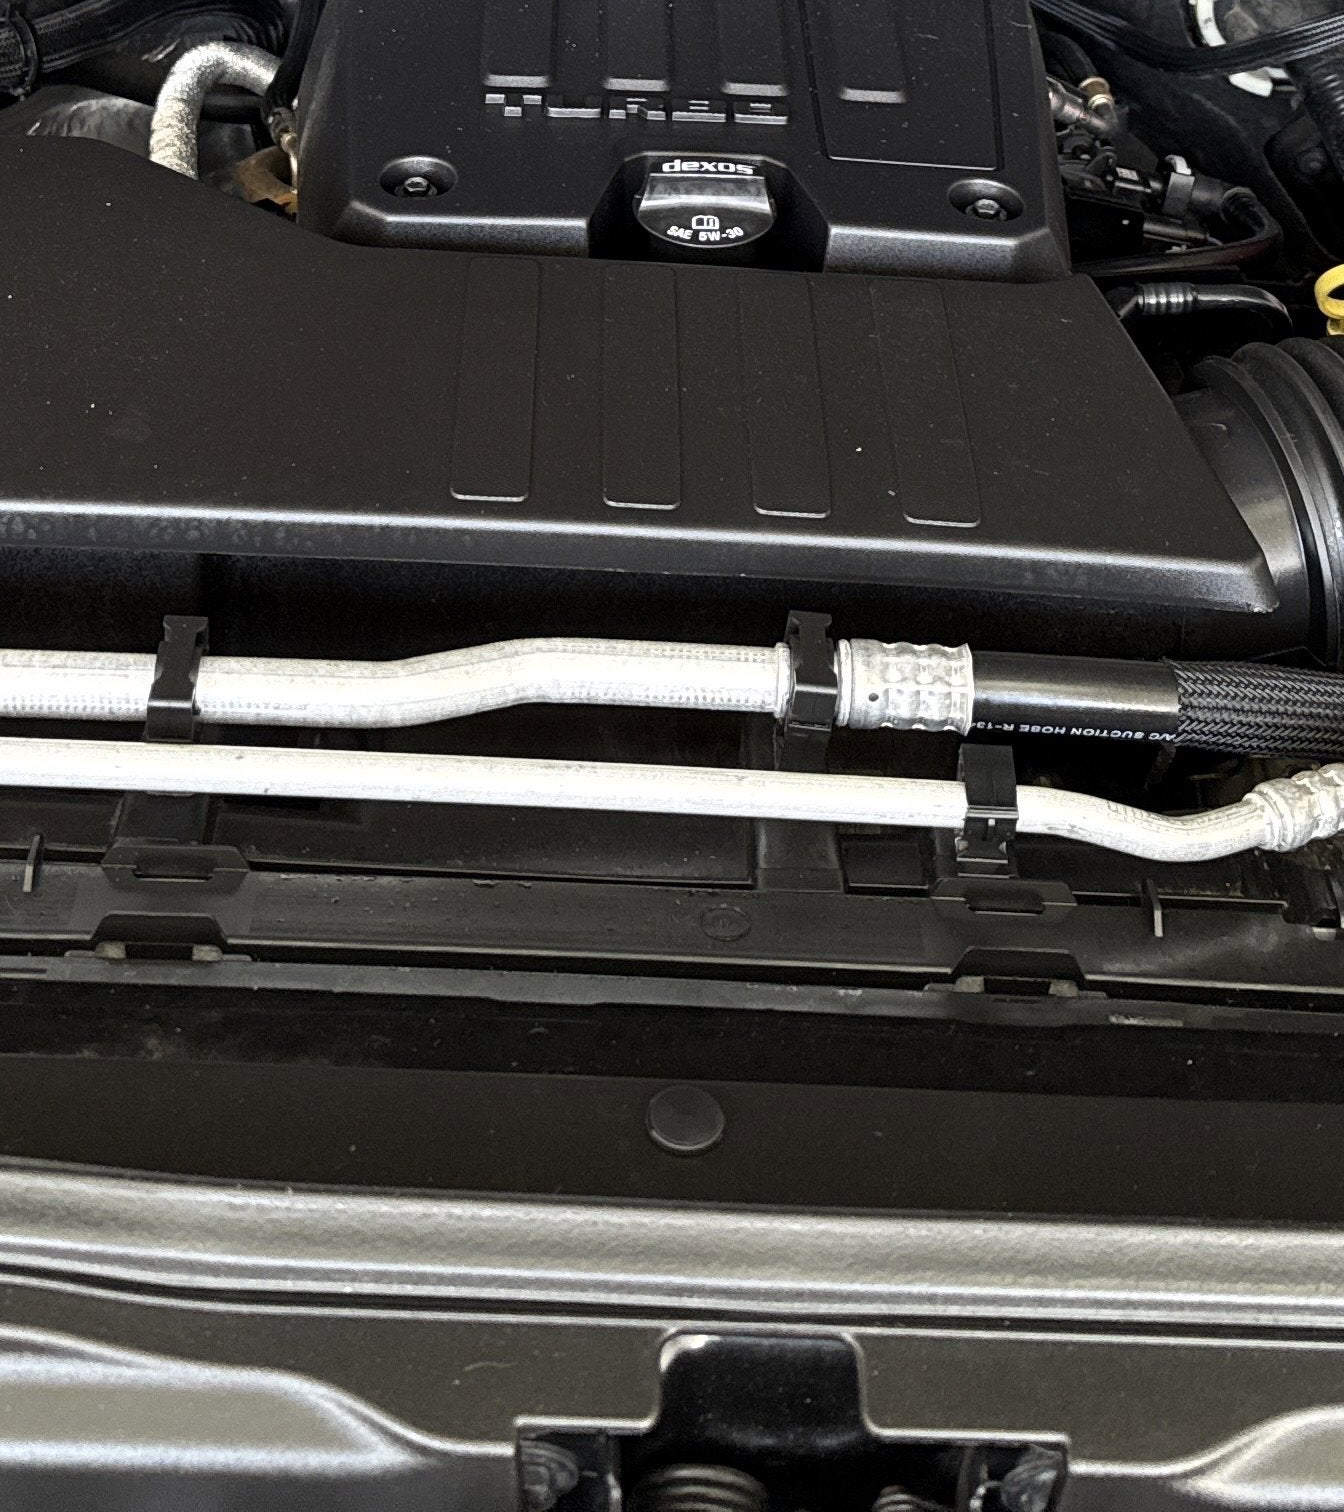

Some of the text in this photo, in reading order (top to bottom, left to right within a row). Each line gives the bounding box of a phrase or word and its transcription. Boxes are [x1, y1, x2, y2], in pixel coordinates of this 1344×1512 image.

[662, 159, 755, 175] dexos
[666, 225, 744, 241] SAE 5W-30
[971, 720, 1014, 731] R-13
[1019, 723, 1066, 734] HOSE
[1070, 727, 1144, 738] SUCTION
